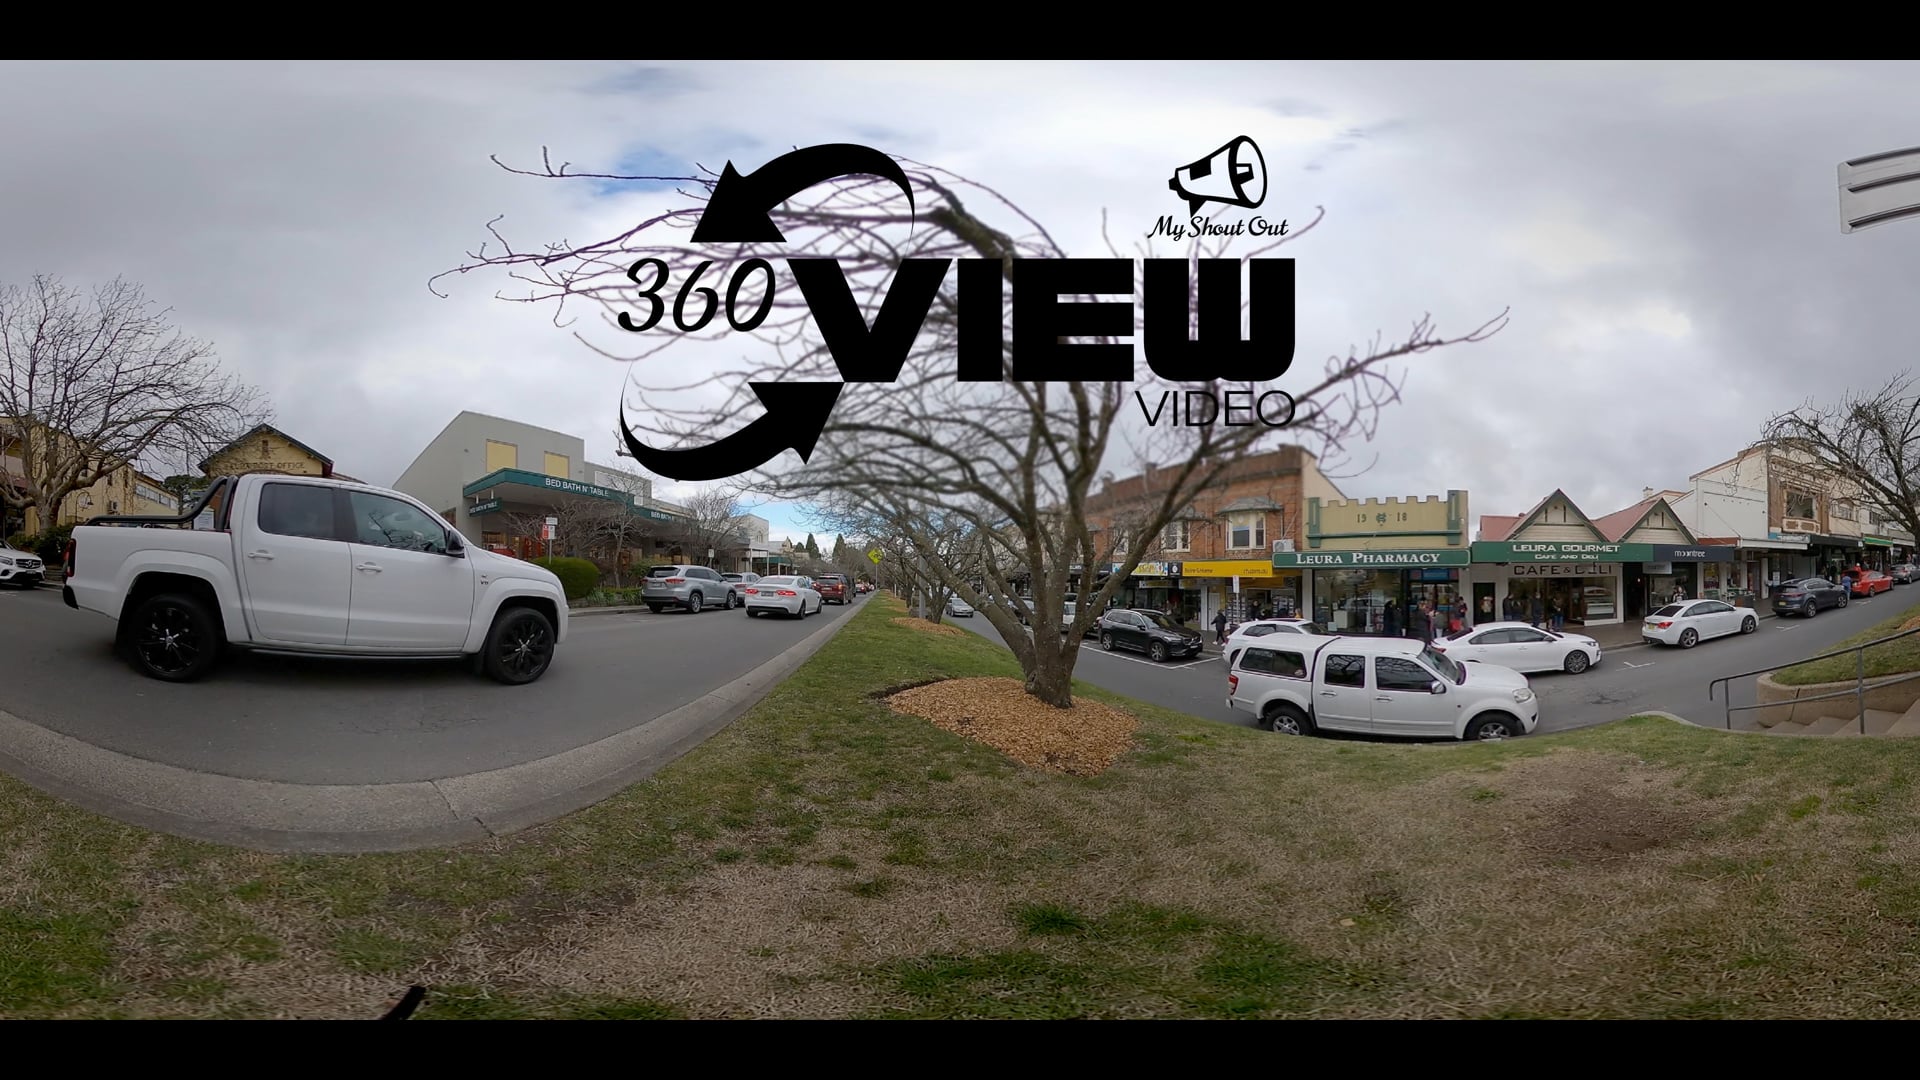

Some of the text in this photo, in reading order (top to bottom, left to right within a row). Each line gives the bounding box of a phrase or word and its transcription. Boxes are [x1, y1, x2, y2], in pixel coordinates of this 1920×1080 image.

[545, 478, 561, 487] BED
[562, 481, 580, 491] BATH
[590, 487, 609, 497] TABLE
[1357, 512, 1408, 523] 19 18
[1512, 544, 1621, 552] LEURA GOURMET
[1296, 552, 1440, 564] LEURA PHARMACY
[1514, 565, 1561, 575] CAFE
